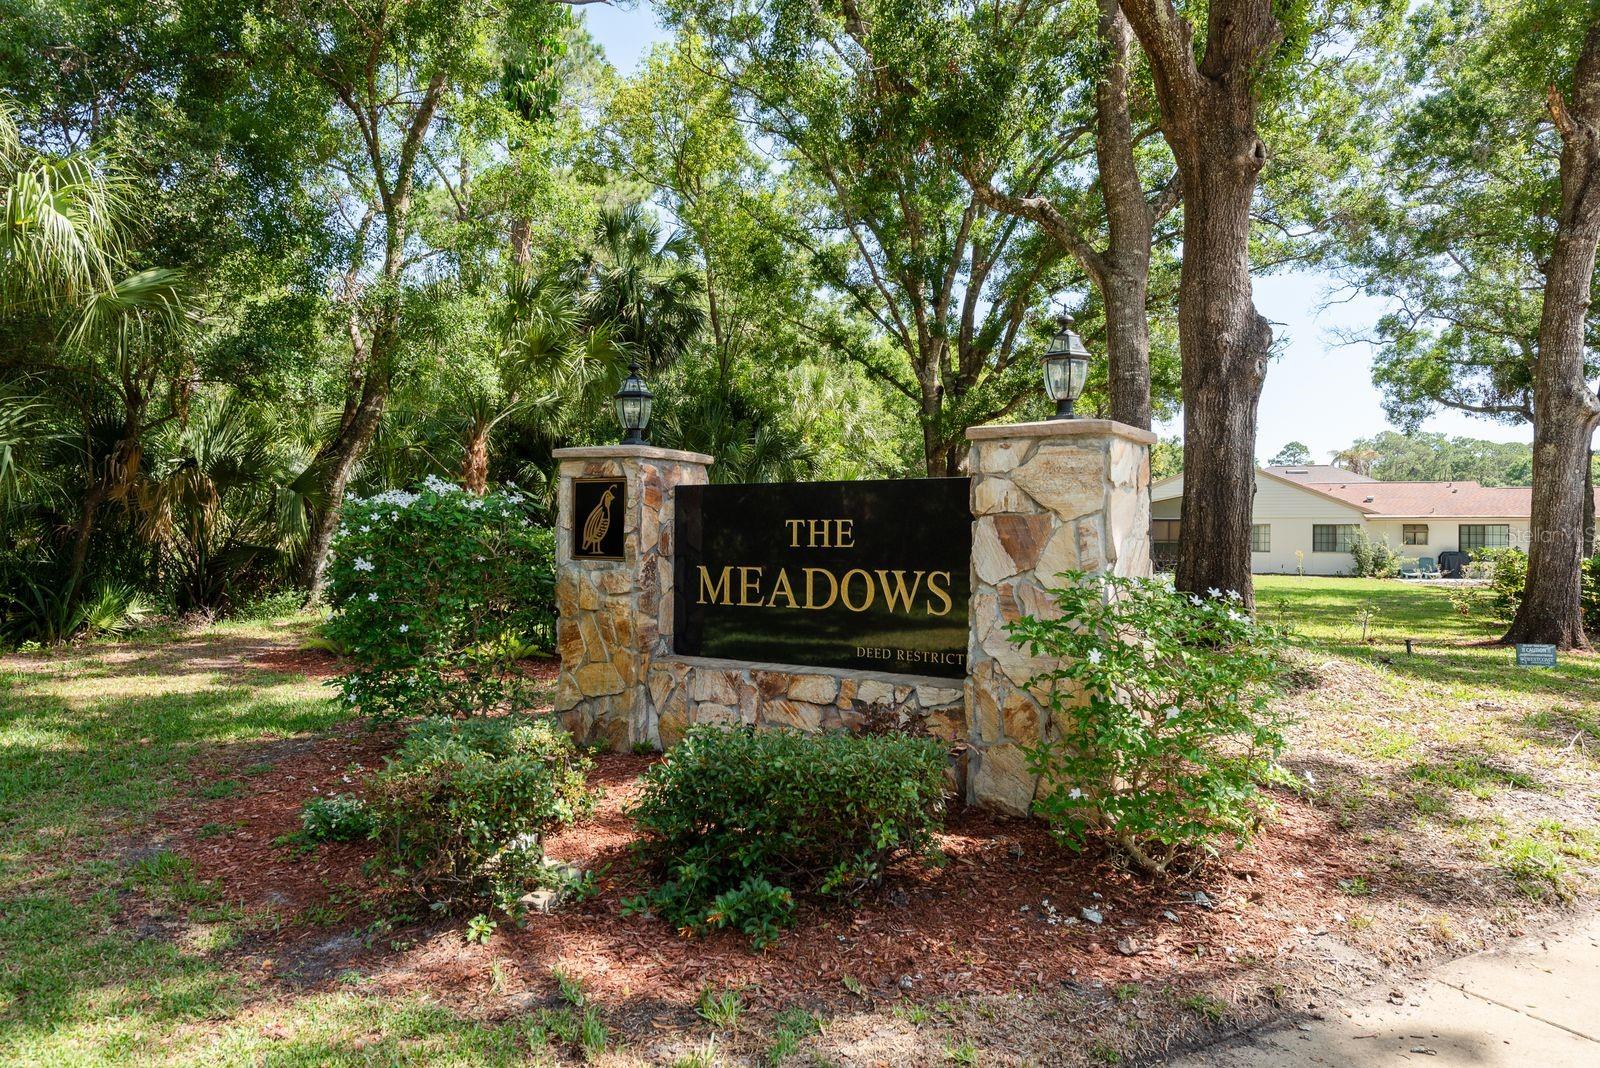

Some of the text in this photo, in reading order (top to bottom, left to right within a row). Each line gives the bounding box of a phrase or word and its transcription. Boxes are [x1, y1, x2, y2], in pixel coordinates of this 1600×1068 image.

[785, 519, 855, 548] THE
[696, 565, 953, 616] MEADOWS
[856, 647, 891, 660] DEED
